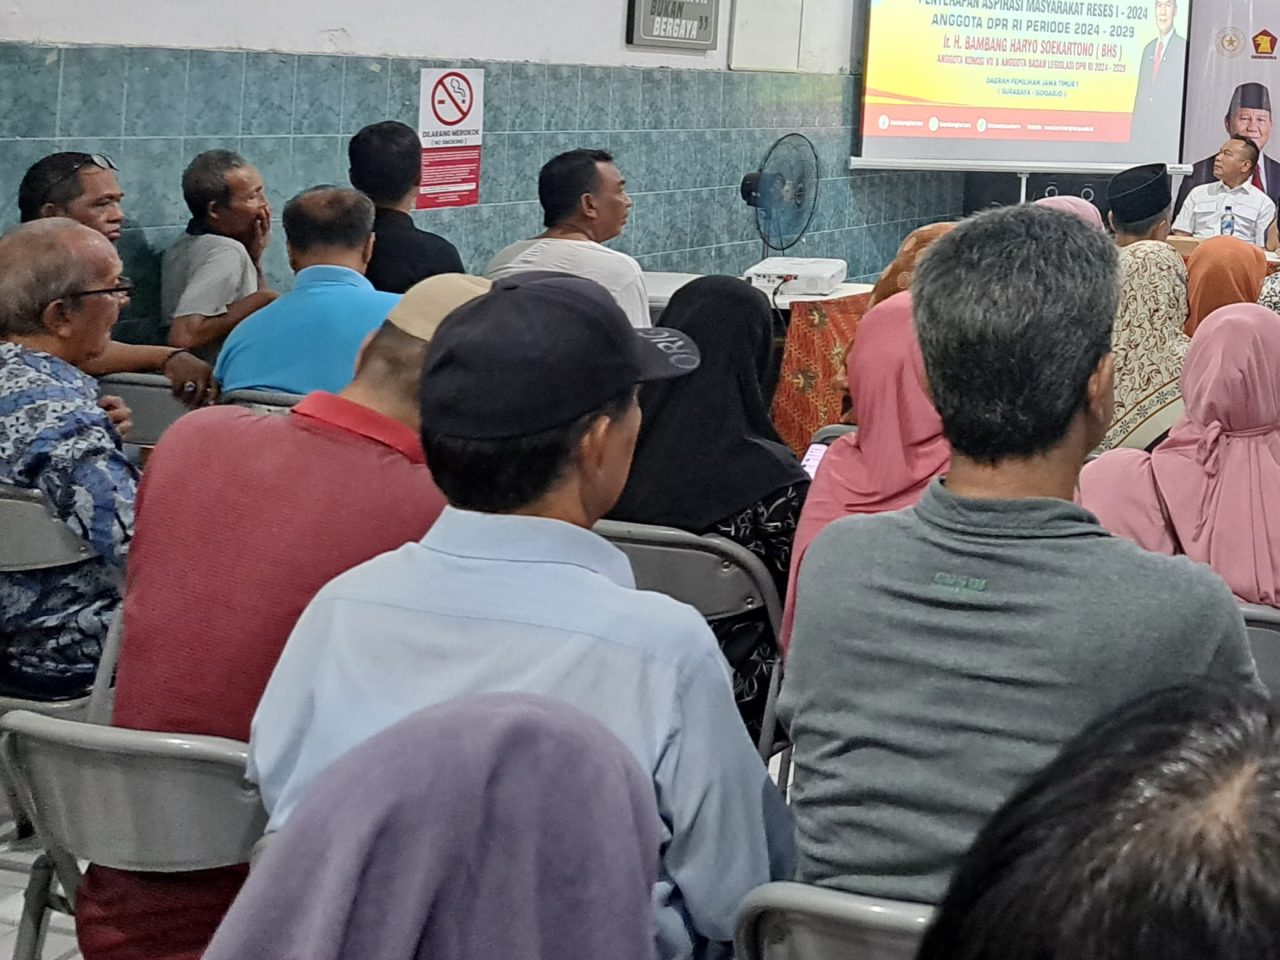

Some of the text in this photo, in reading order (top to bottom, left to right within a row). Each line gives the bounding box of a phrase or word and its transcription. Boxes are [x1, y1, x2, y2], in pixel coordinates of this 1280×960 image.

[1086, 2, 1114, 18] RESES
[1126, 6, 1148, 20] 2024
[931, 13, 983, 28] ANGGOTA
[986, 17, 1009, 30] DPR
[1012, 19, 1022, 31] RI
[1026, 20, 1071, 34] PERIODE
[1074, 23, 1100, 36] 2024
[1109, 25, 1135, 38] 2029
[953, 34, 962, 50] H.
[964, 35, 1007, 52] BAMBANG
[1009, 38, 1038, 54] HARYO
[1040, 40, 1094, 57] SOEKARTONO
[1101, 43, 1117, 58] BHS
[937, 54, 963, 64] ANGGOTA
[1001, 58, 1027, 68] ANGGOTA
[1047, 60, 1074, 70] LEGISLASI
[1075, 61, 1087, 71] DPR
[1094, 62, 1108, 72] 2024
[422, 130, 450, 138] DILARANG
